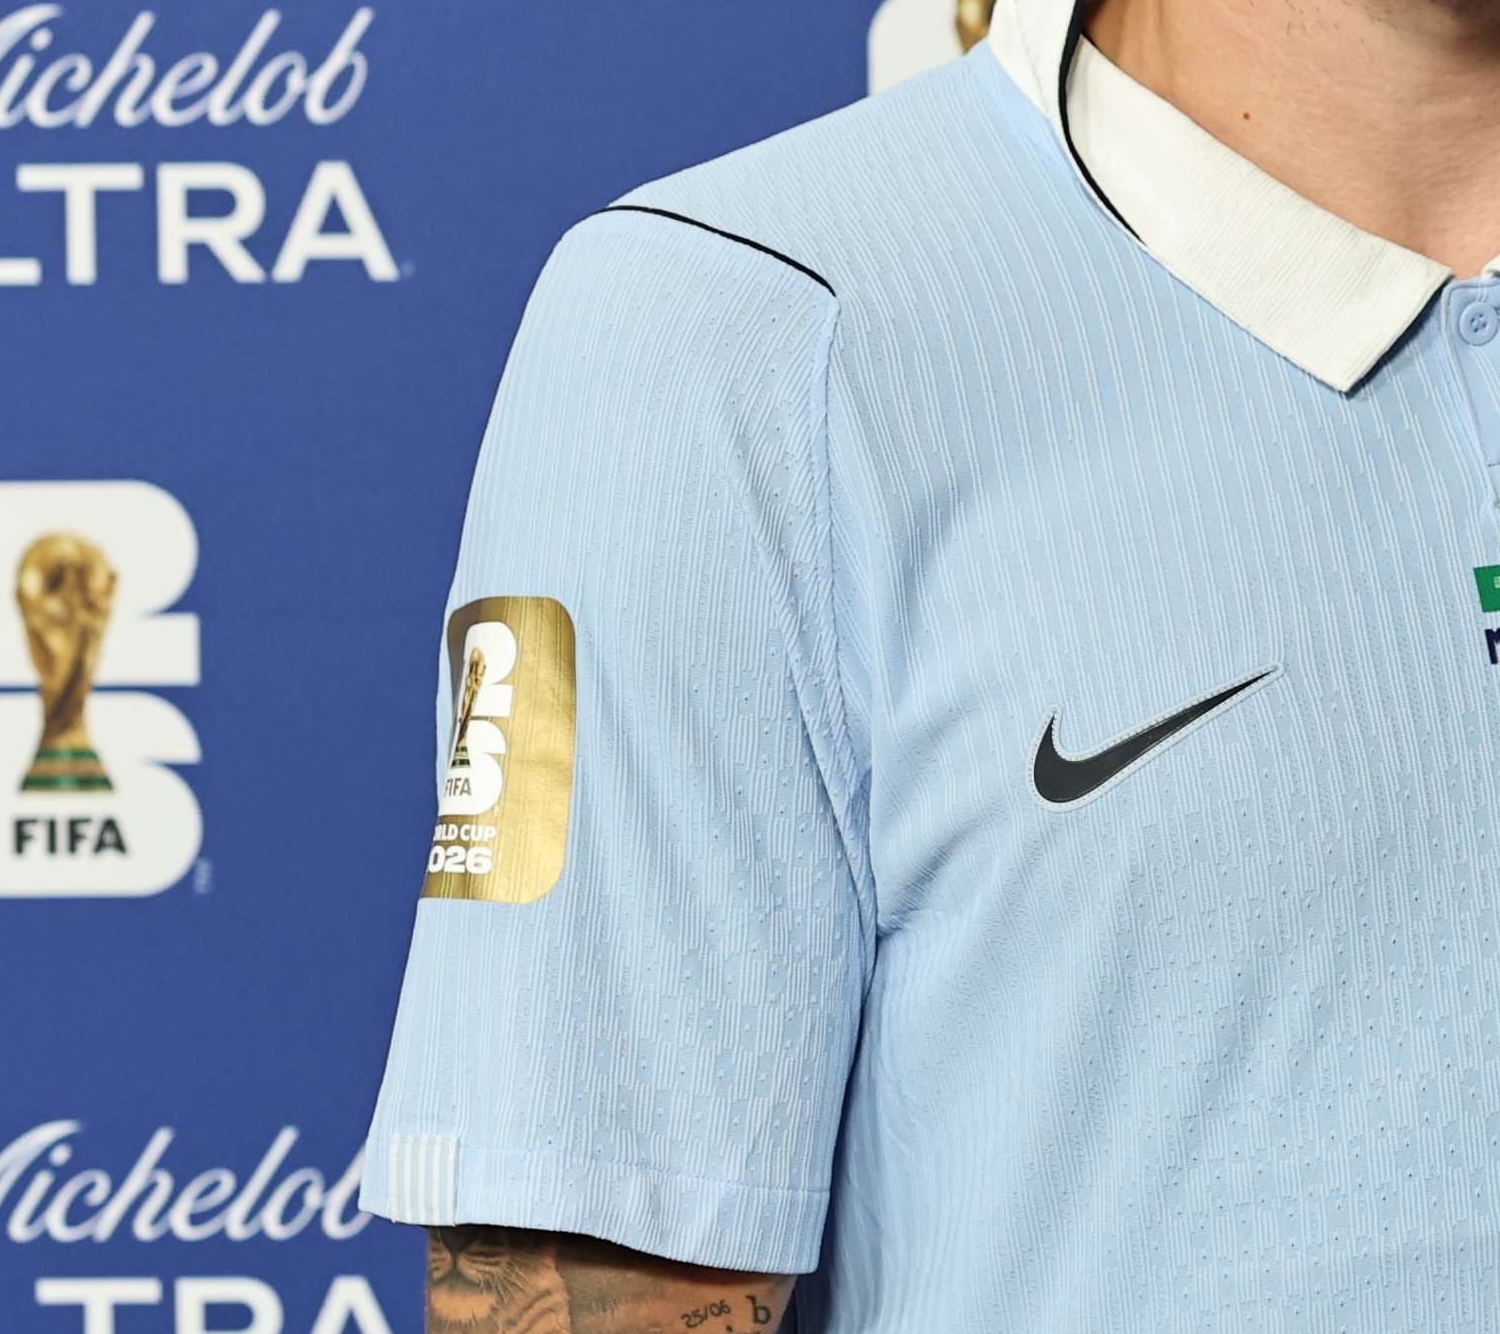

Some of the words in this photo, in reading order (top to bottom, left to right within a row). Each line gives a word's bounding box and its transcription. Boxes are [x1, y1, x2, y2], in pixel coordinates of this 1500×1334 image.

[15, 819, 126, 854] FIFA
[460, 823, 496, 842] CUP
[428, 845, 492, 874] 026
[680, 1300, 731, 1329] 25/06
